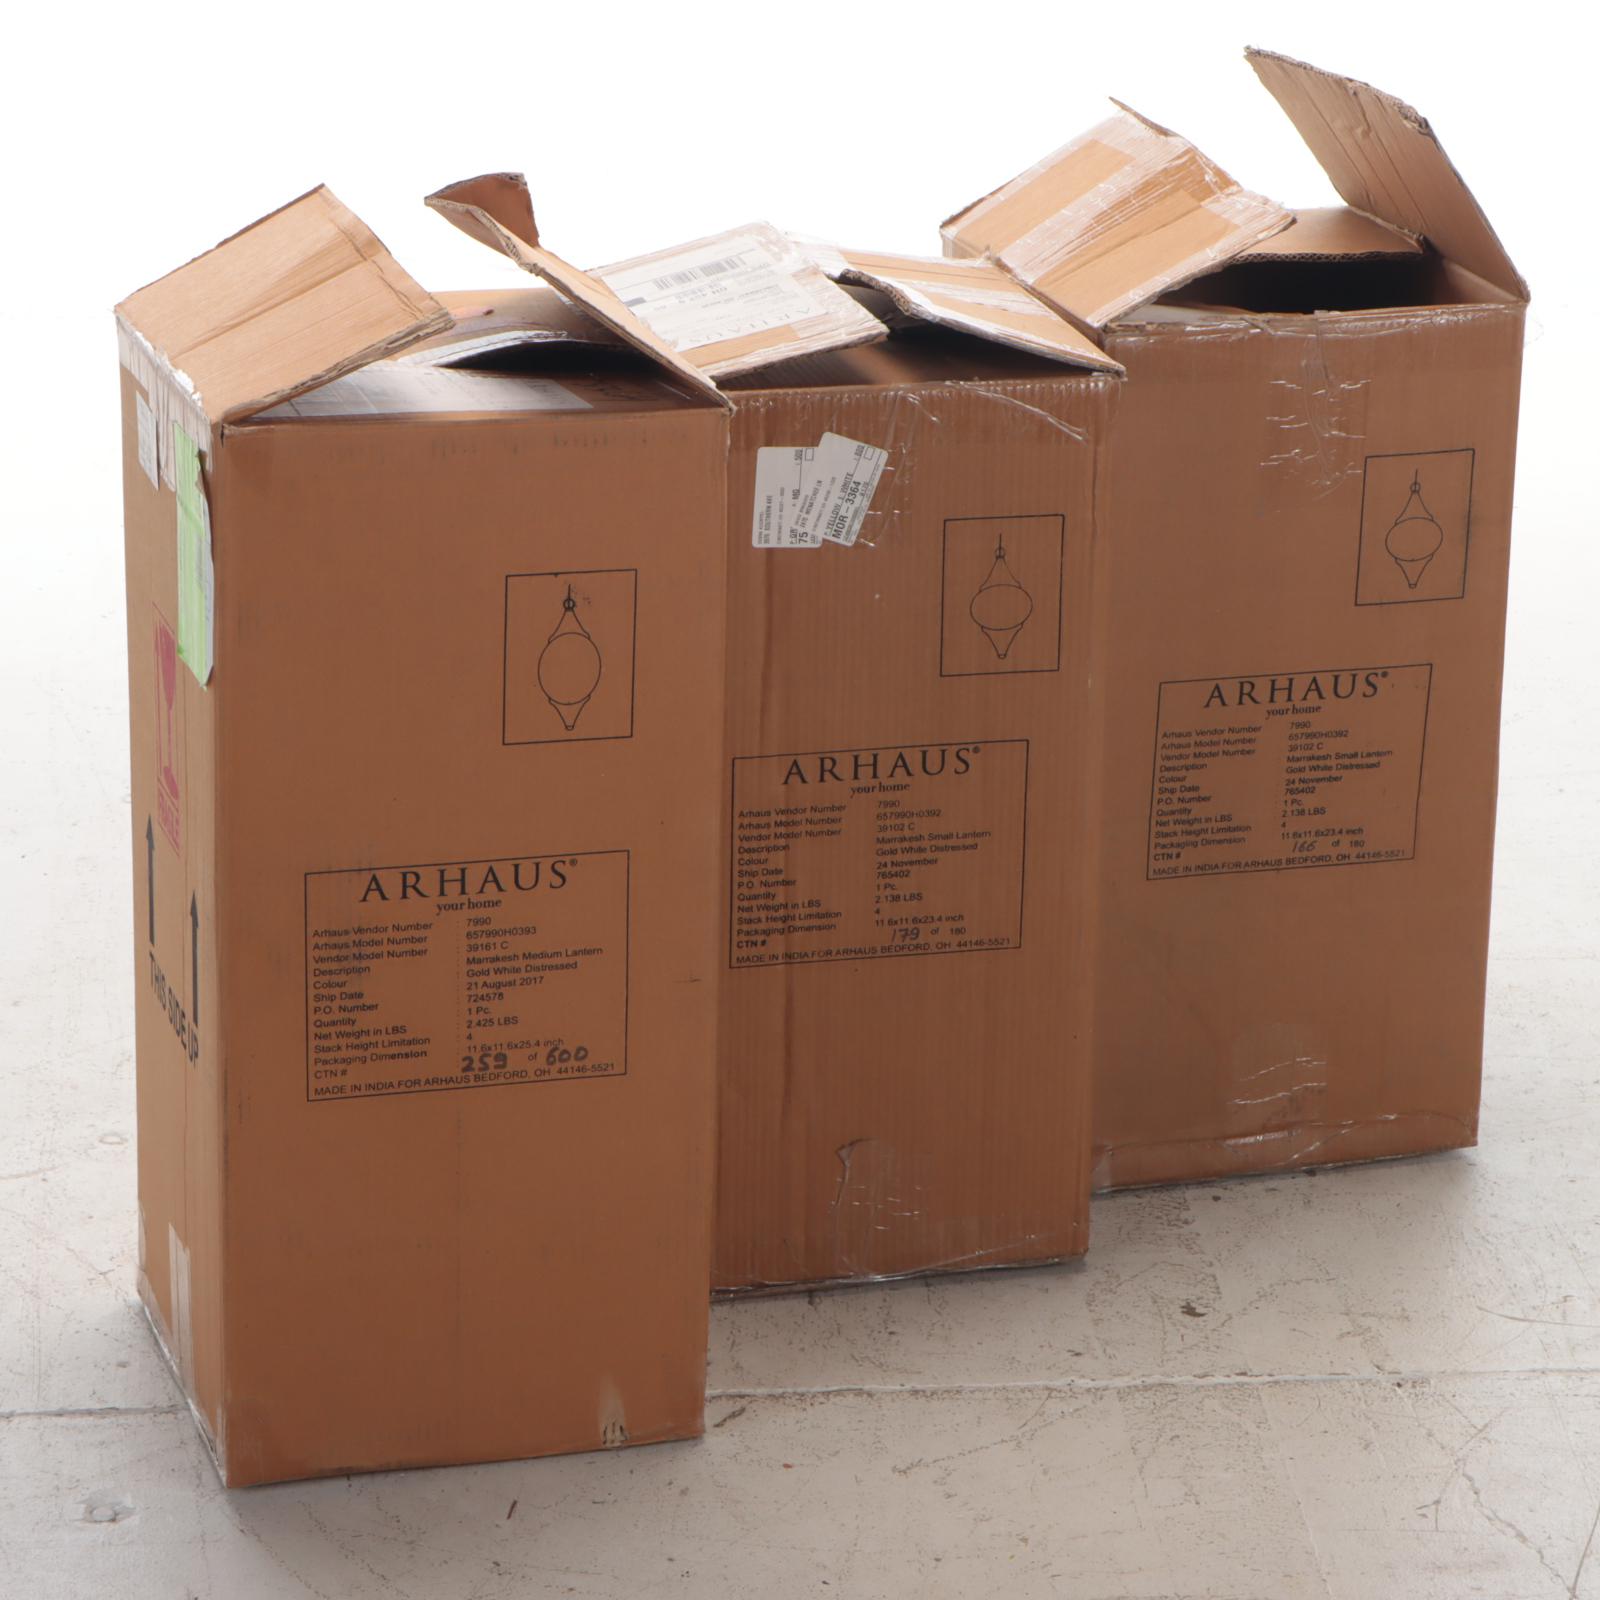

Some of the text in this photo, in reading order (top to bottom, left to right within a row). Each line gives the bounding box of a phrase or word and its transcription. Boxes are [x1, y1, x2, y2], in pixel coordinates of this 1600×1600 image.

[436, 897, 502, 916] your home
[312, 916, 492, 938] Arhaus Vendor Number 7990
[312, 942, 349, 951] Arhaus
[352, 938, 384, 949] Model
[387, 935, 428, 946] Number
[313, 954, 349, 964] Vendor
[352, 950, 384, 962] Model
[386, 948, 428, 959] Number
[500, 941, 508, 950] C
[313, 948, 603, 977] Description Marrakesh Medium Lantern
[313, 961, 578, 990] Colour Gold White Distressed
[313, 976, 544, 1003] Ship Date 21 August 2017
[313, 1017, 357, 1029] Quantity
[468, 1007, 472, 1016] 1
[338, 1003, 379, 1013] Number
[314, 1032, 332, 1041] Net
[335, 1028, 370, 1040] Weight
[373, 1028, 382, 1036] in
[385, 1025, 407, 1035] LBS
[497, 1016, 519, 1026] LBS
[314, 1032, 472, 1054] Stack Height Limitation 4
[314, 1056, 367, 1066] Packaging
[370, 1050, 427, 1062] Dimension
[543, 1038, 564, 1048] inch
[314, 1069, 338, 1080] CTN
[461, 1052, 508, 1074] 259
[528, 1052, 537, 1061] of
[545, 1044, 588, 1066] 600
[314, 1085, 347, 1096] MADE
[350, 1084, 362, 1093] IN
[365, 1081, 395, 1091] INDIA
[397, 1078, 421, 1089] FOR
[423, 1075, 471, 1086] ARHAUS
[534, 1068, 551, 1078] OH
